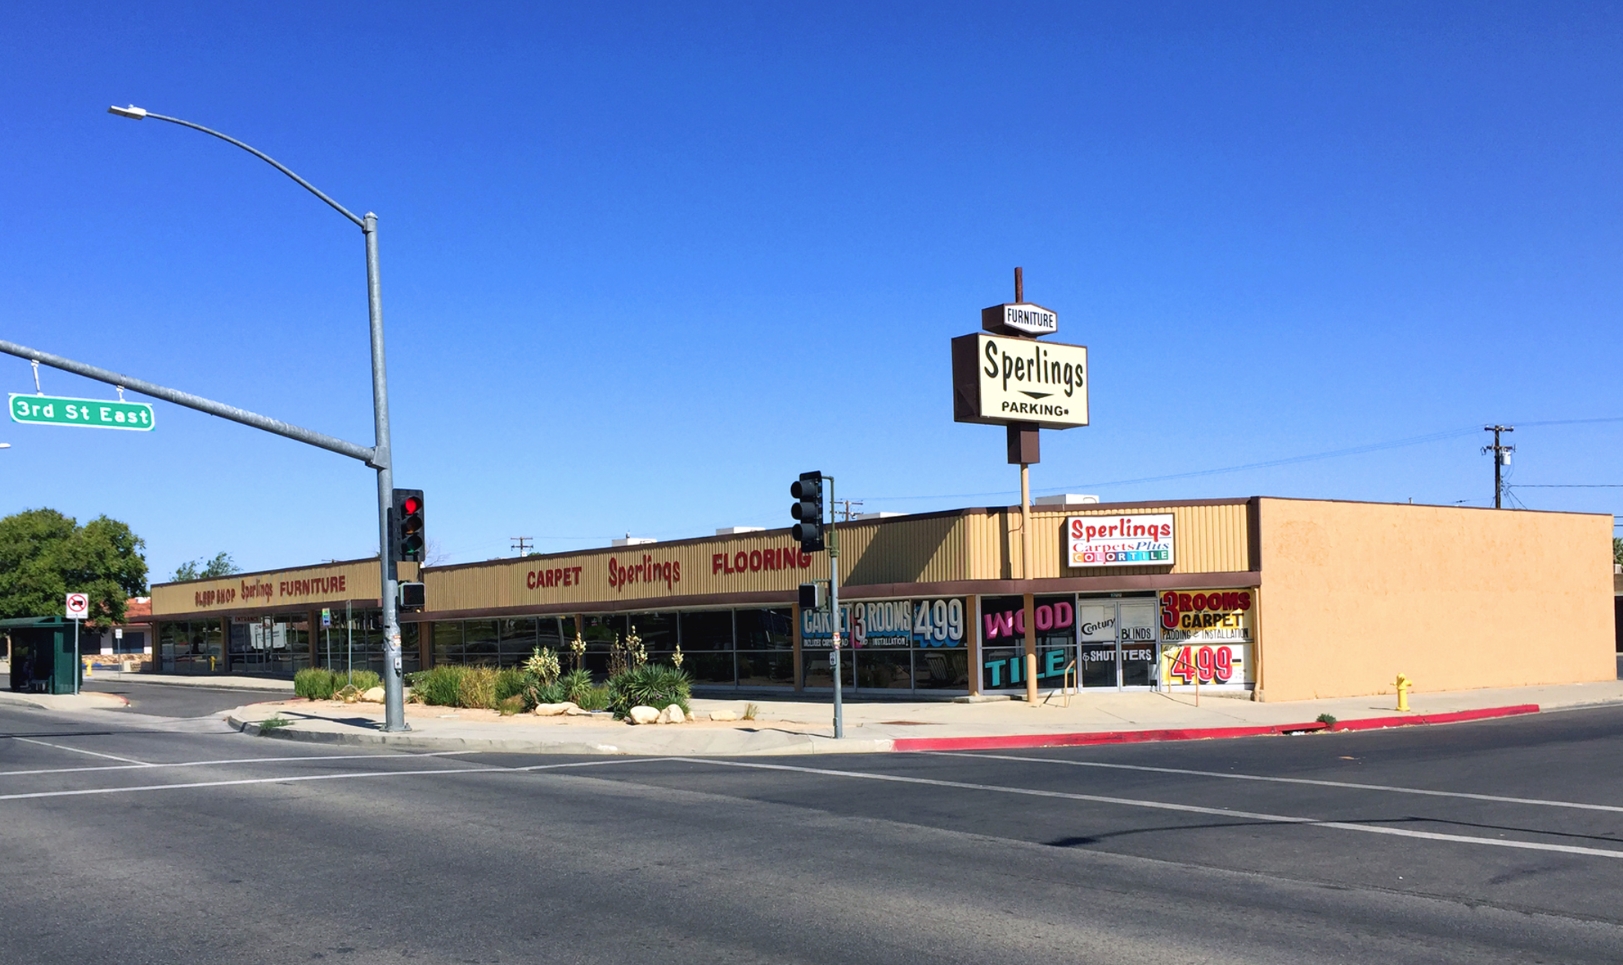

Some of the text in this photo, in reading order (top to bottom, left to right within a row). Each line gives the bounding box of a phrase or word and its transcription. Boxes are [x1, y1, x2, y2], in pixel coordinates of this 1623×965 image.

[1007, 308, 1054, 328] FURNITURE
[984, 340, 1084, 397] Sperlings
[16, 401, 149, 424] 3rd St East
[1001, 401, 1063, 417] PARKING
[1071, 518, 1171, 542] Sperlings
[527, 547, 812, 592] CARPET Sperlings FLOORING
[216, 588, 236, 605] SHOP
[241, 579, 273, 603] Sperlings
[279, 575, 346, 597] FURNITURE
[802, 603, 850, 633] CARET
[854, 602, 867, 641] 3
[867, 601, 910, 632] ROOMS
[984, 601, 1073, 640] WOOD
[1161, 591, 1251, 630] 3 ROOMS
[1181, 613, 1244, 628] CARPET
[1081, 618, 1116, 636] Century
[1121, 628, 1151, 640] BLINDS
[1162, 630, 1191, 640] PADDING
[1090, 649, 1152, 662] SHUTTERS
[985, 649, 1074, 687] TILE
